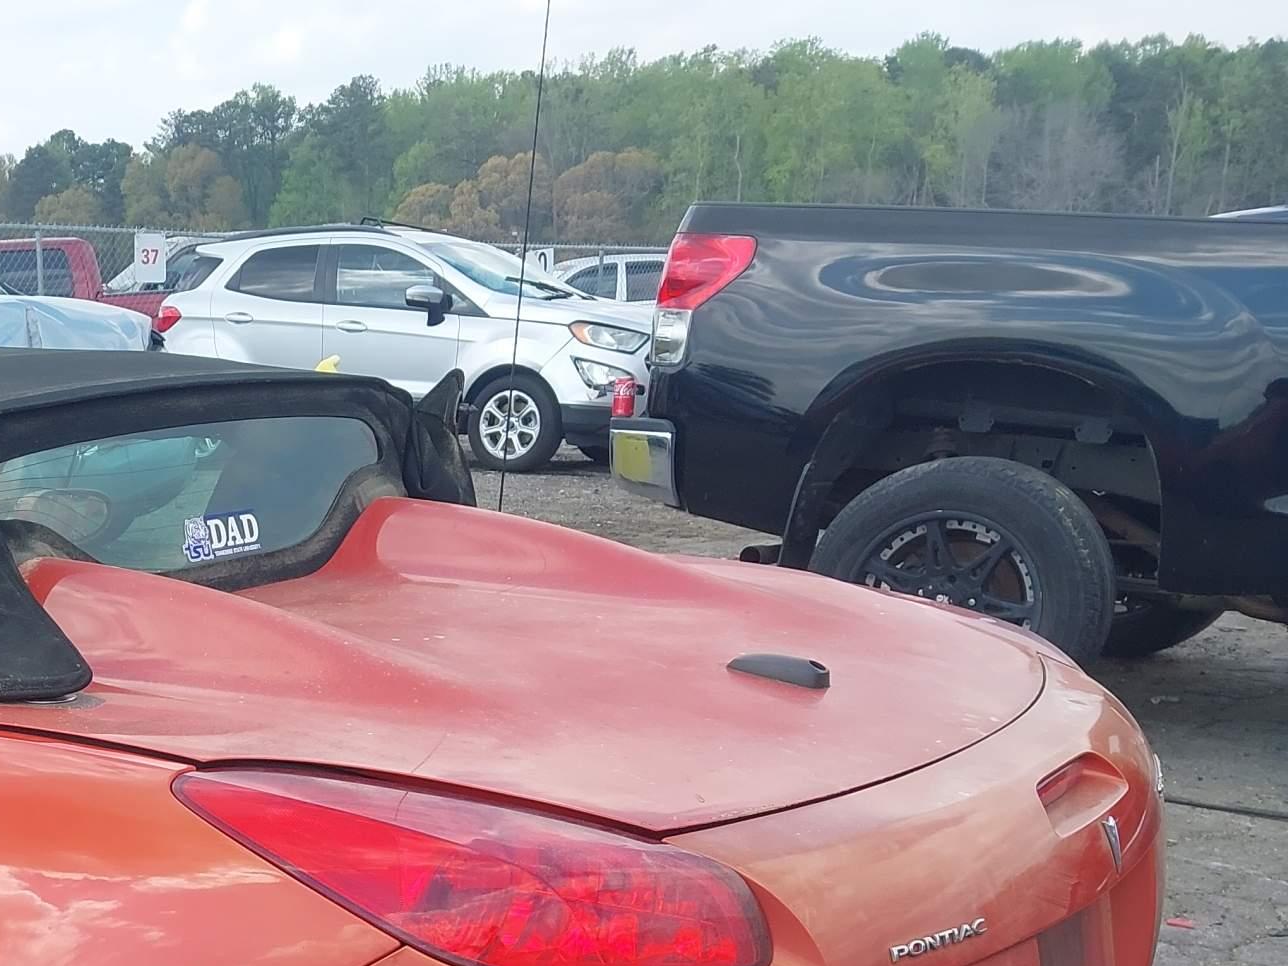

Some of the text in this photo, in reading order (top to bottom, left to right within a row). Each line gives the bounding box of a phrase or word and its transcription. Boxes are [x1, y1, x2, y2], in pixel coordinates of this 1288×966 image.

[141, 248, 159, 265] 37
[206, 513, 259, 549] DAD
[889, 917, 989, 964] PONTIAC
